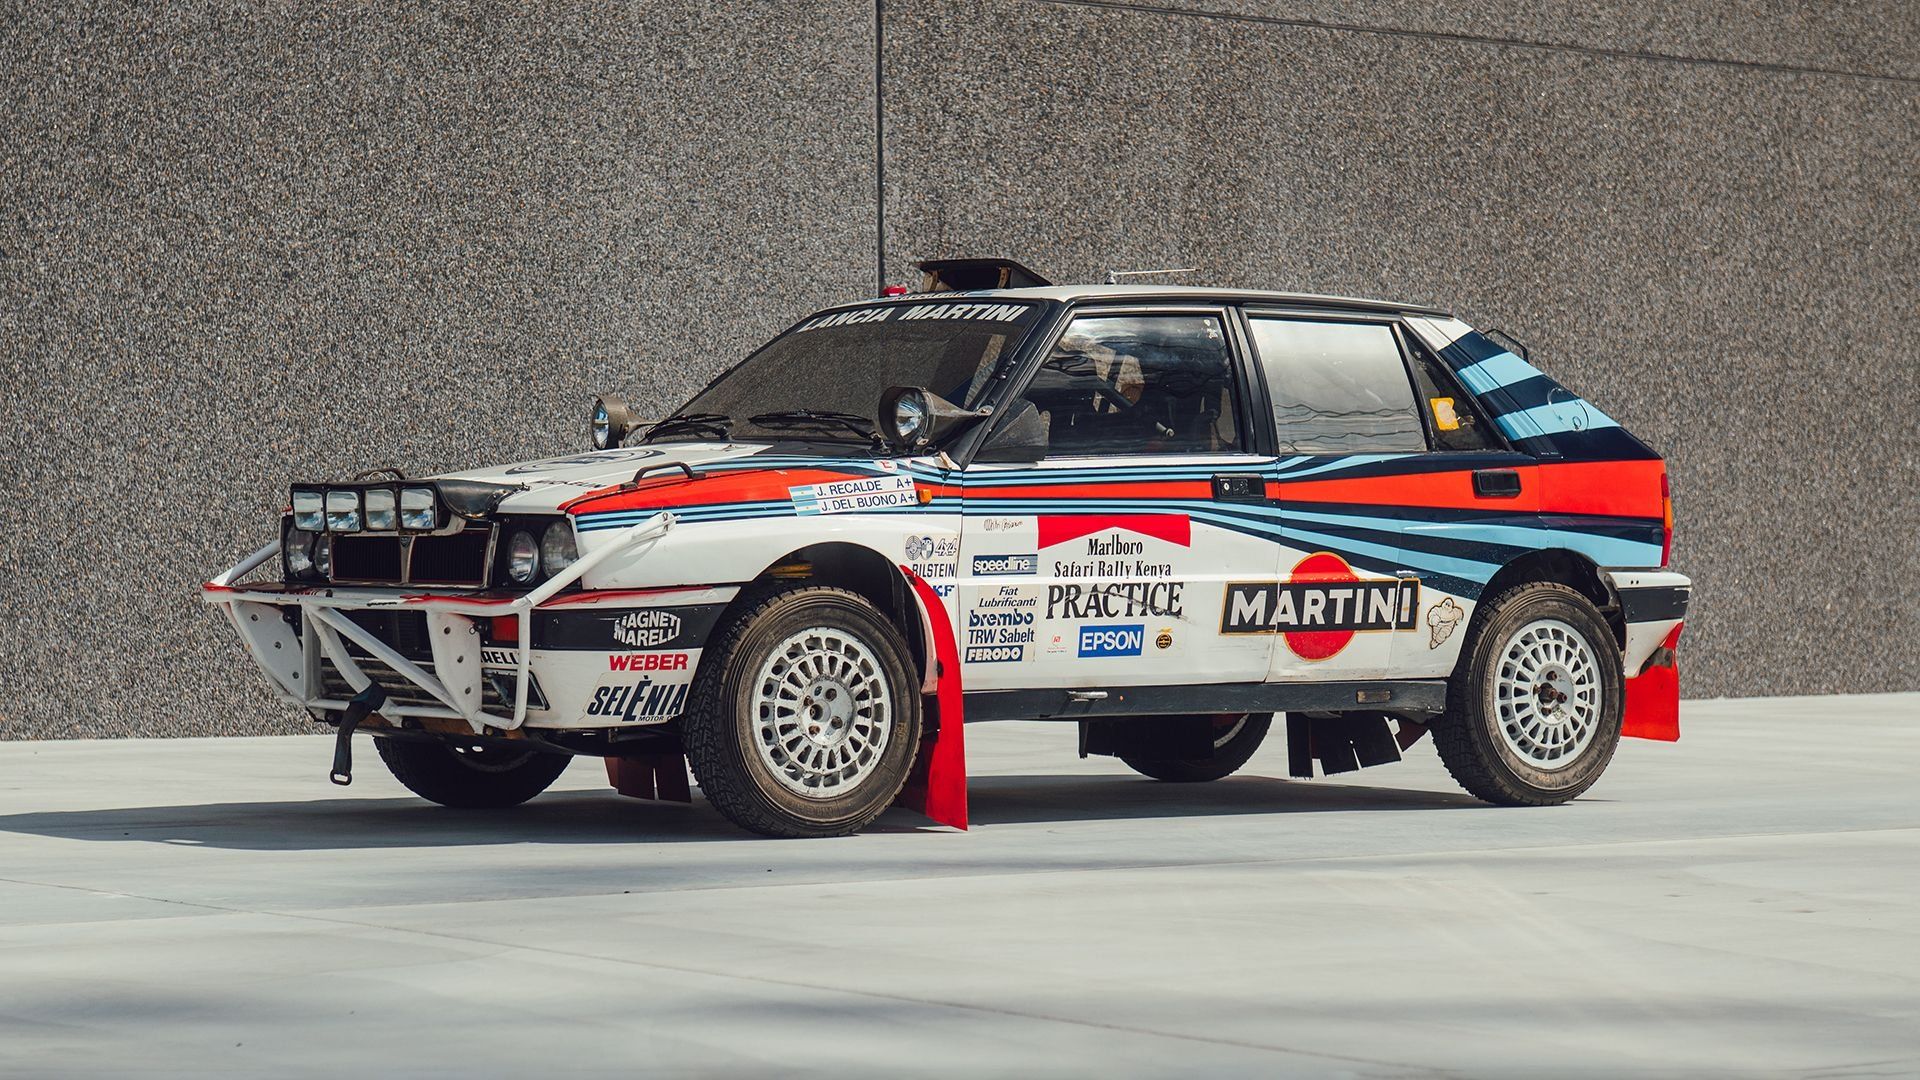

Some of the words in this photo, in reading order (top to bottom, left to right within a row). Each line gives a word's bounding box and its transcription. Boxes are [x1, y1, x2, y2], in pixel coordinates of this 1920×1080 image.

[796, 307, 896, 333] LANCIA
[898, 304, 1029, 322] MARTINI
[817, 486, 827, 497] J.
[829, 480, 882, 496] RECALDE
[821, 502, 831, 512] J.
[833, 499, 855, 510] DEL
[857, 494, 897, 508] BUONO
[935, 537, 958, 557] 4x4
[1087, 534, 1143, 556] Marlboro
[912, 563, 955, 578] BILSTEIN
[973, 556, 1030, 575] speedline
[1054, 561, 1093, 578] Safari
[1098, 560, 1132, 579] Rally
[1135, 560, 1171, 578] Kenya
[932, 585, 955, 597] KF
[999, 586, 1019, 596] Fiat
[1045, 581, 1184, 620] PRACTICE
[979, 597, 1038, 608] Lubrificanti
[1229, 587, 1412, 626] MARTINI
[969, 608, 1034, 627] brembo
[613, 627, 680, 646] MARELLI
[968, 629, 997, 644] TRW
[999, 628, 1035, 643] Sabelt
[1081, 630, 1141, 651] EPSON
[609, 653, 689, 671] WEBER
[967, 647, 1021, 661] FERODO
